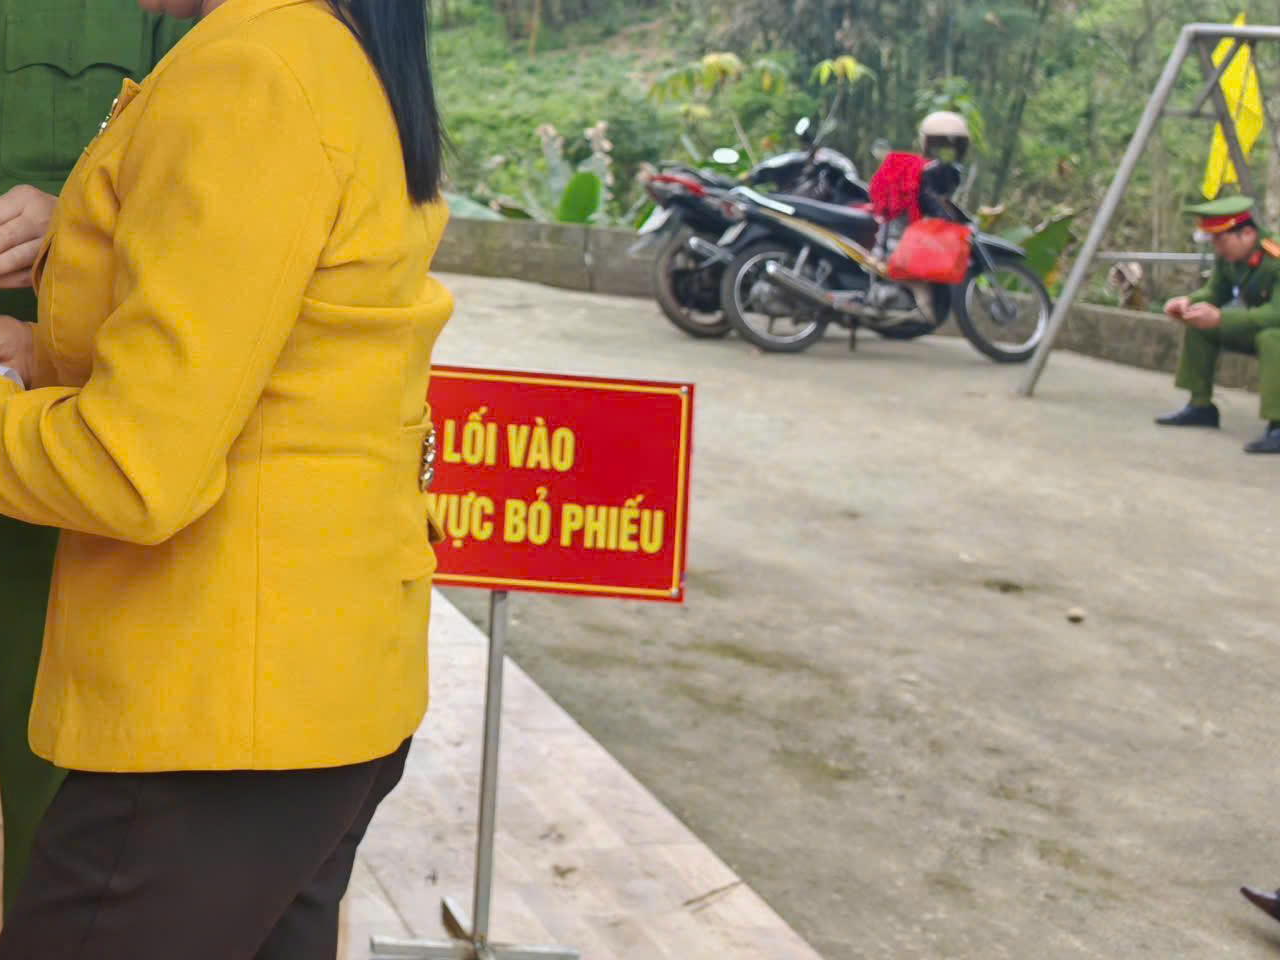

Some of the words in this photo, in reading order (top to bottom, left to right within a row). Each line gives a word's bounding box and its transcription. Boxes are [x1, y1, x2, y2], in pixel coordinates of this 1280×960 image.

[442, 406, 498, 466] LỐI
[507, 416, 576, 472] VÀO
[504, 486, 552, 546] BỎ
[560, 494, 665, 554] PHIẾU
